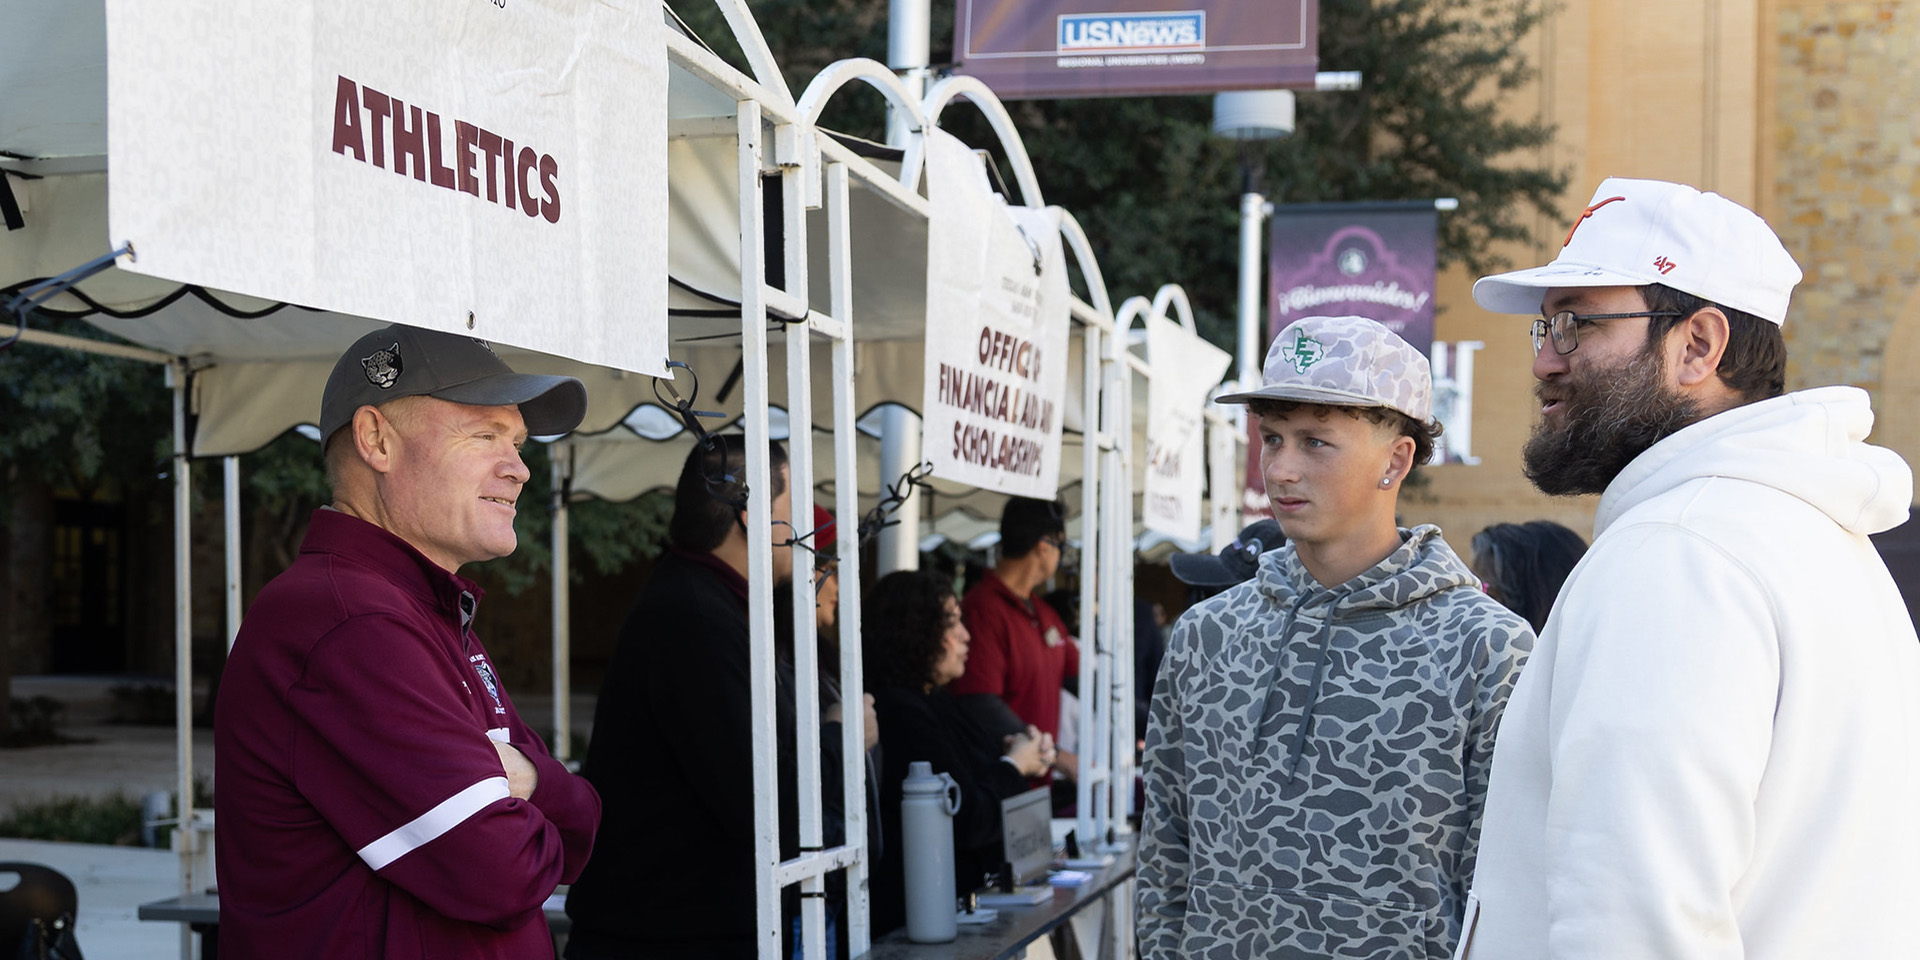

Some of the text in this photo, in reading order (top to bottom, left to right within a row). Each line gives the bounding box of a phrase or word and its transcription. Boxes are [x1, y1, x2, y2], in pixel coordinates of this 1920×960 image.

[1057, 56, 1104, 68] REGIONAL
[332, 74, 561, 224] ATHLETICS
[939, 362, 1021, 424] FINANCIAL
[1020, 392, 1039, 430] AID
[953, 420, 1044, 478] SCHOLARSHIPS
